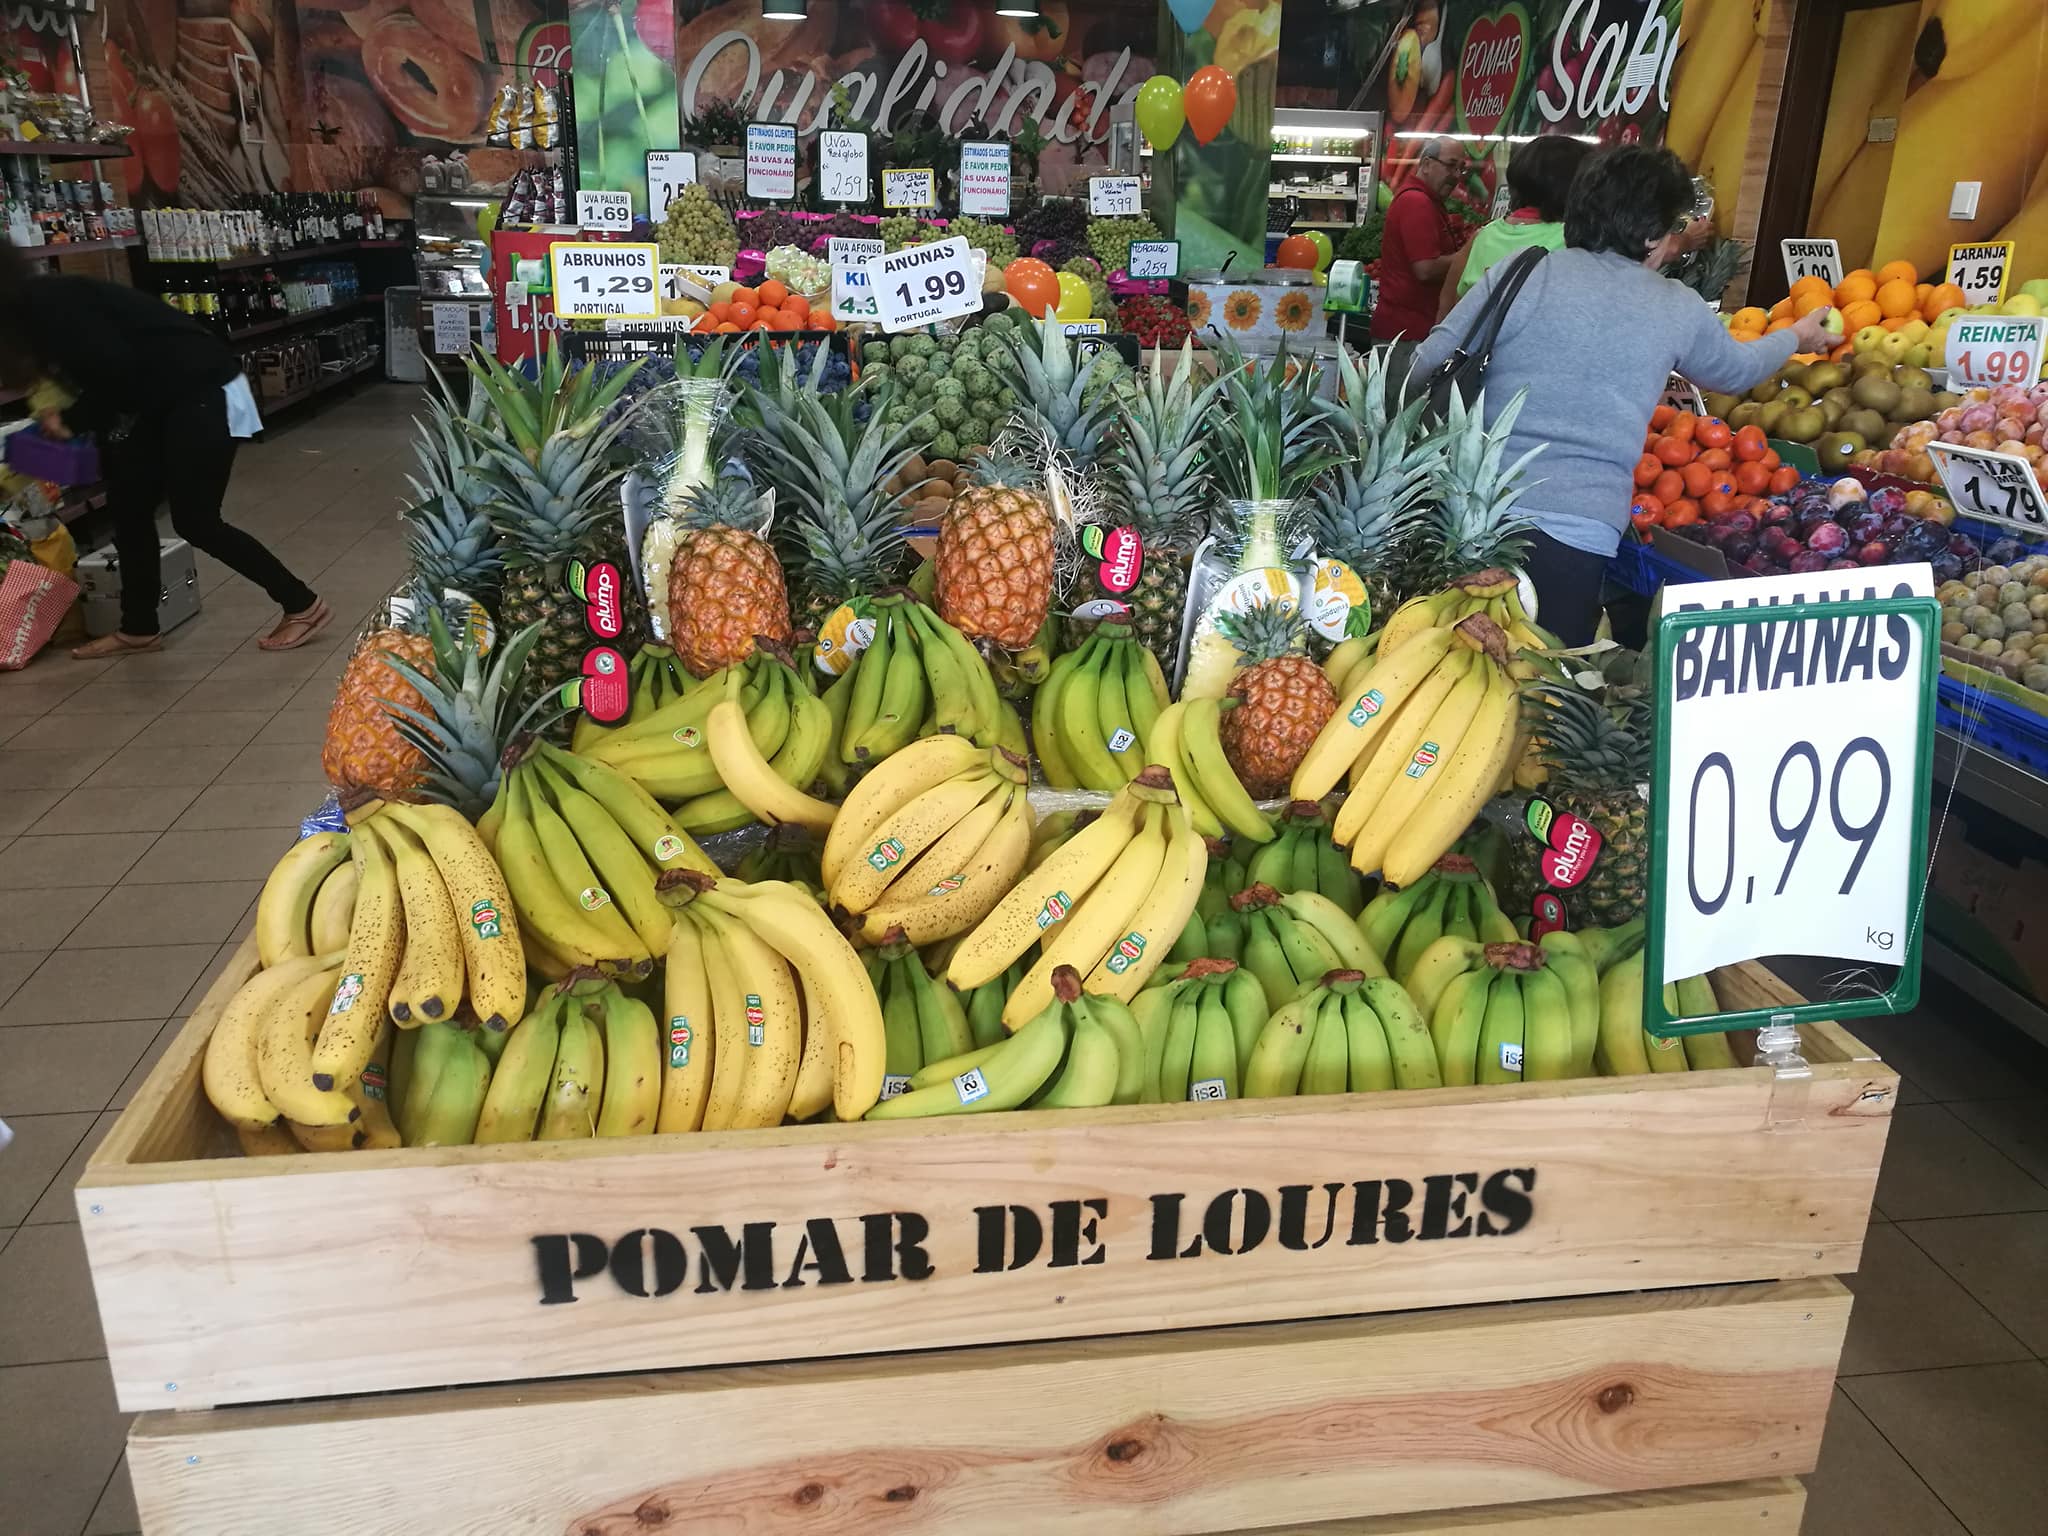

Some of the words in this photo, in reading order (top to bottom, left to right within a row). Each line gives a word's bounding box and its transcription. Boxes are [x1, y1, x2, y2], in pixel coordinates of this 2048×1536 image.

[1462, 34, 1521, 80] POMAR
[1481, 79, 1492, 96] de
[1464, 88, 1505, 118] Loures
[755, 143, 776, 152] FAVOR
[648, 154, 670, 162] UVAS
[749, 155, 759, 163] AS
[761, 156, 782, 164] UVAS
[784, 157, 796, 165] AO
[970, 162, 990, 171] FAVOR
[964, 174, 974, 182] AS
[975, 175, 996, 183] UVAS
[584, 194, 599, 204] UVA
[600, 195, 628, 205] PALIERI
[584, 206, 629, 221] 1.69
[833, 242, 849, 252] UVA
[851, 243, 882, 254] AFONSO
[1788, 244, 1834, 258] BRAVO
[1953, 246, 2007, 261] LARANJA
[563, 253, 646, 267] ABRUNHOS
[574, 276, 653, 297] 1,29
[1954, 265, 2004, 290] 1.59
[896, 270, 966, 308] 1.99
[894, 307, 943, 324] PORTUGAL
[1958, 324, 2037, 342] REINETA
[1957, 350, 2030, 383] 1.99
[1964, 476, 2044, 523] 1.79
[1110, 533, 1136, 587] plump
[596, 573, 617, 633] plump
[1675, 582, 1912, 702] BANANAS
[1687, 736, 1892, 916] 0,99
[1554, 822, 1592, 884] plump
[1866, 926, 1895, 951] kg
[531, 1208, 935, 1305] POMAR
[973, 1198, 1108, 1275] DE
[1146, 1167, 1538, 1261] LOURES
